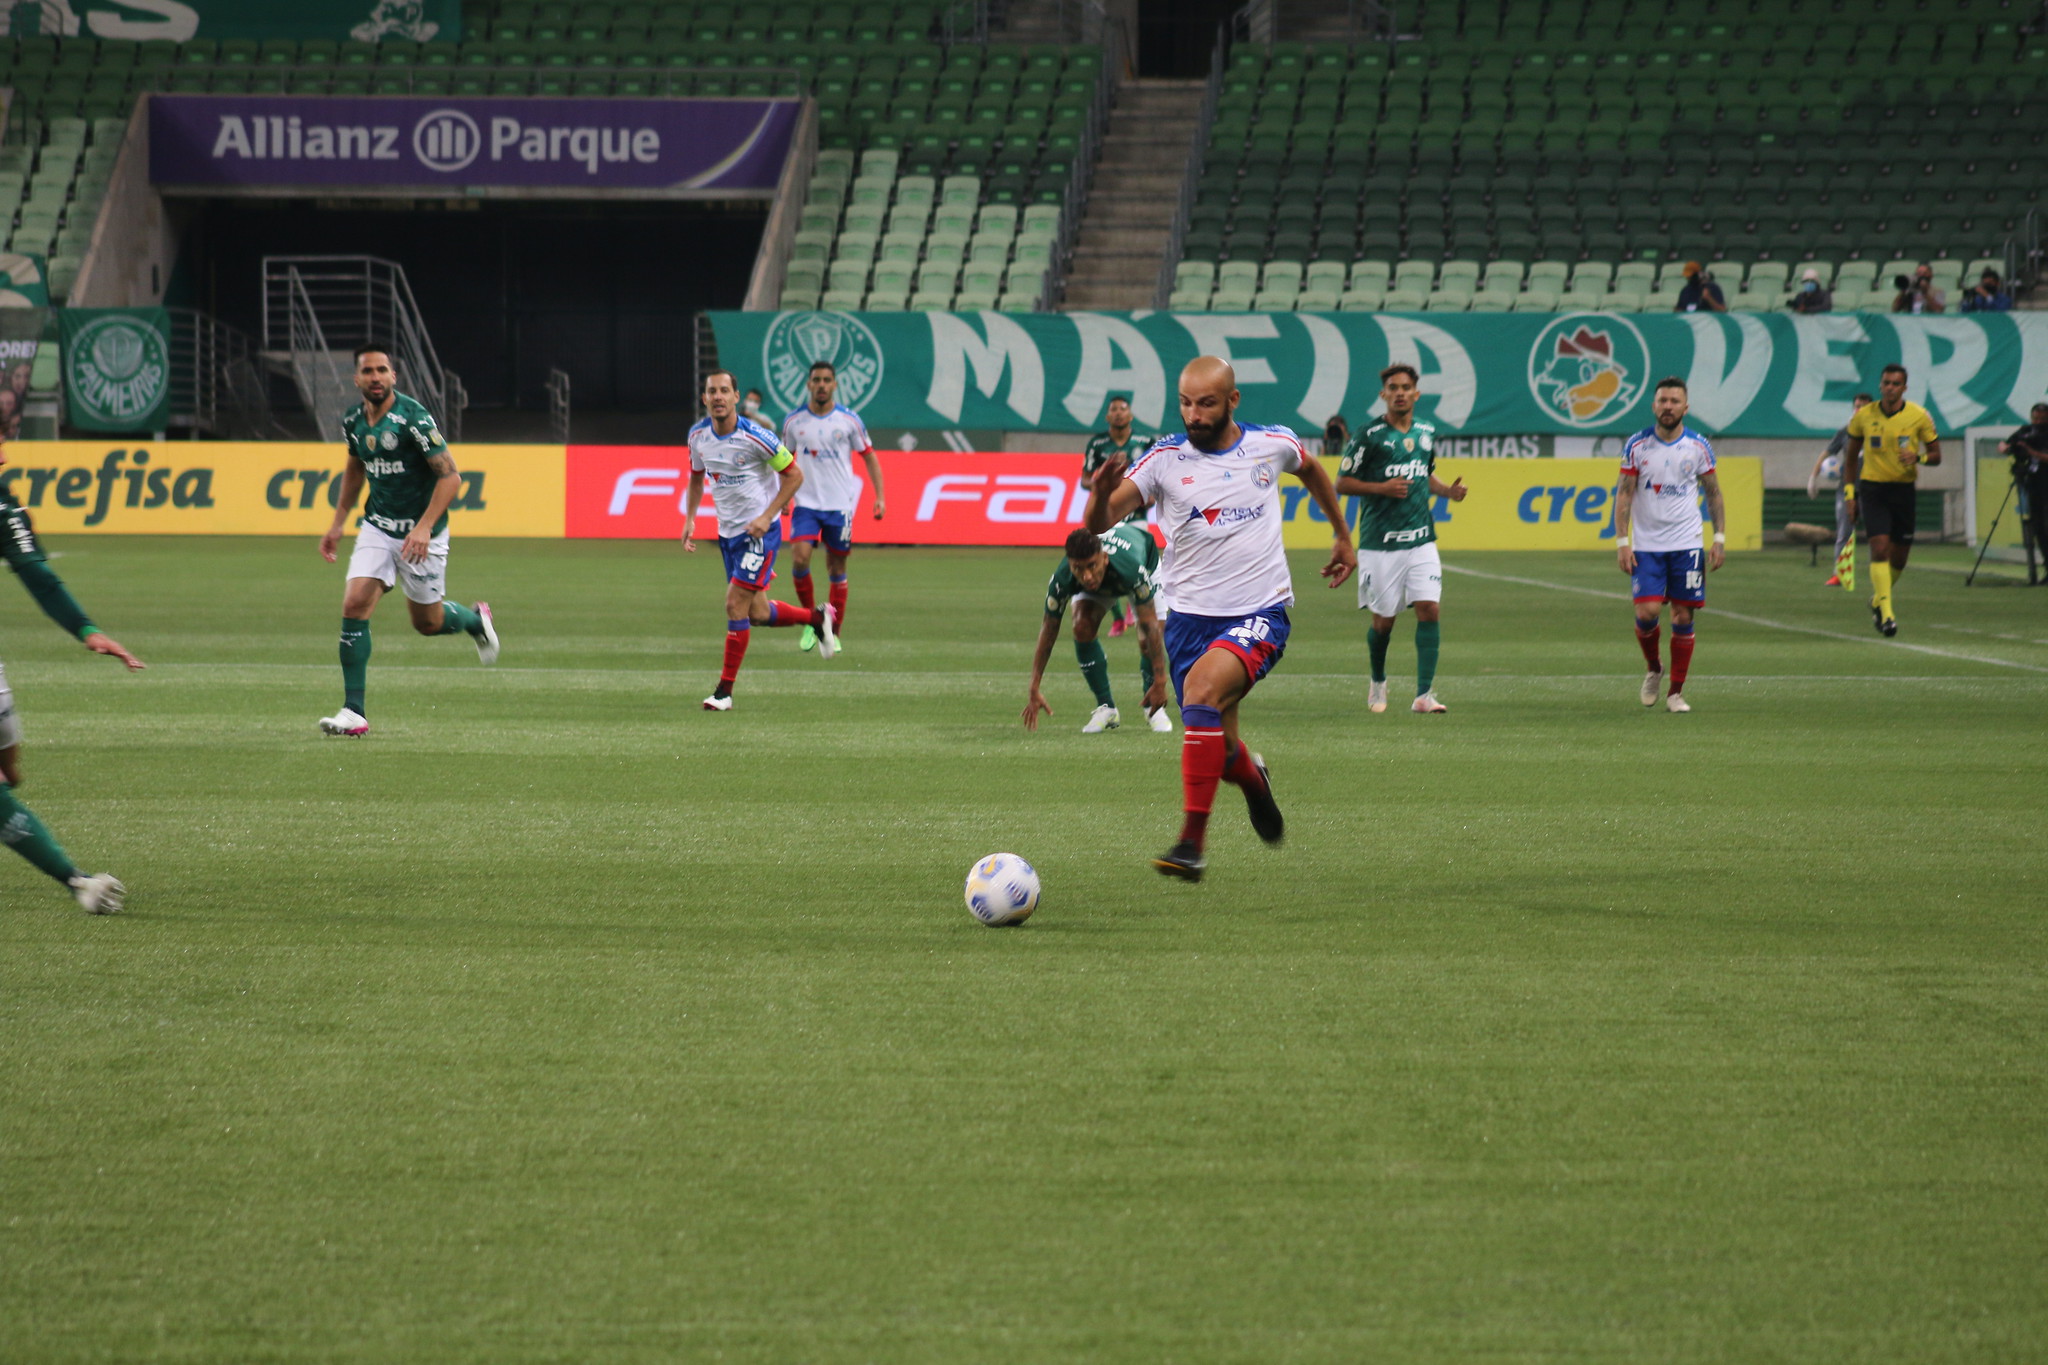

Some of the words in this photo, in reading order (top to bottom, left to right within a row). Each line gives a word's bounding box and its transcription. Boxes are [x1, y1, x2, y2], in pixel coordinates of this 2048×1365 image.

[212, 116, 400, 160] Allianz
[491, 117, 661, 174] Parque
[77, 362, 162, 417] PALMEIRAS
[770, 352, 877, 408] PALIRAS
[926, 311, 1476, 429] MAFIA
[1383, 525, 1430, 544] Fam
[1689, 550, 1700, 569] 7
